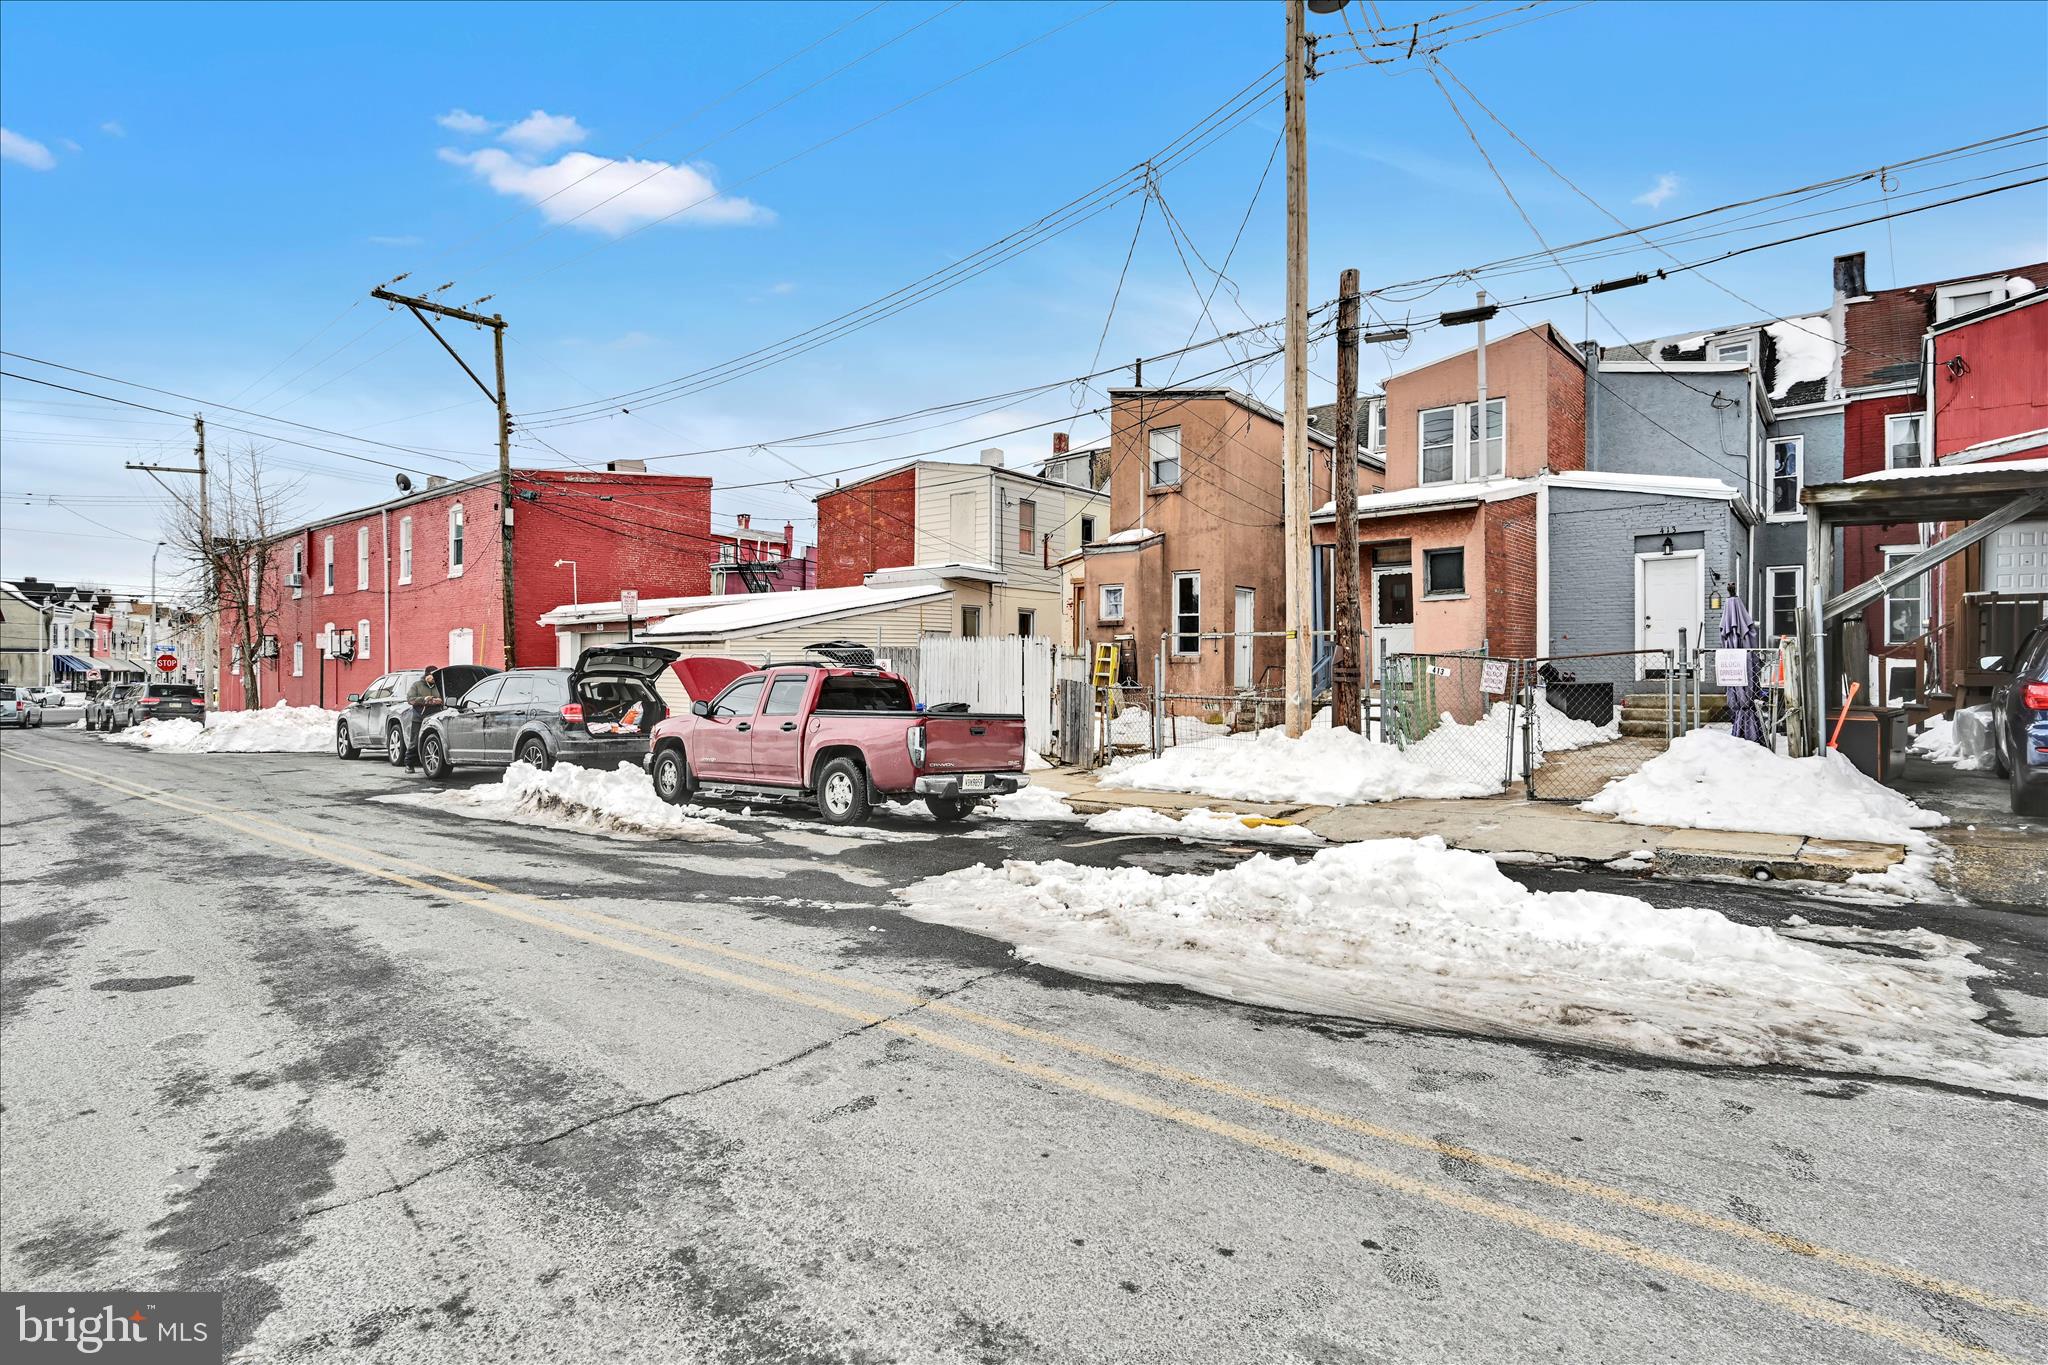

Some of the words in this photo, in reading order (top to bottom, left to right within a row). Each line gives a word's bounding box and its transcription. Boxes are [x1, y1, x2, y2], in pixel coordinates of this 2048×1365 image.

[1659, 525, 1677, 535] 413
[157, 659, 177, 667] STOP
[1432, 667, 1445, 676] 413
